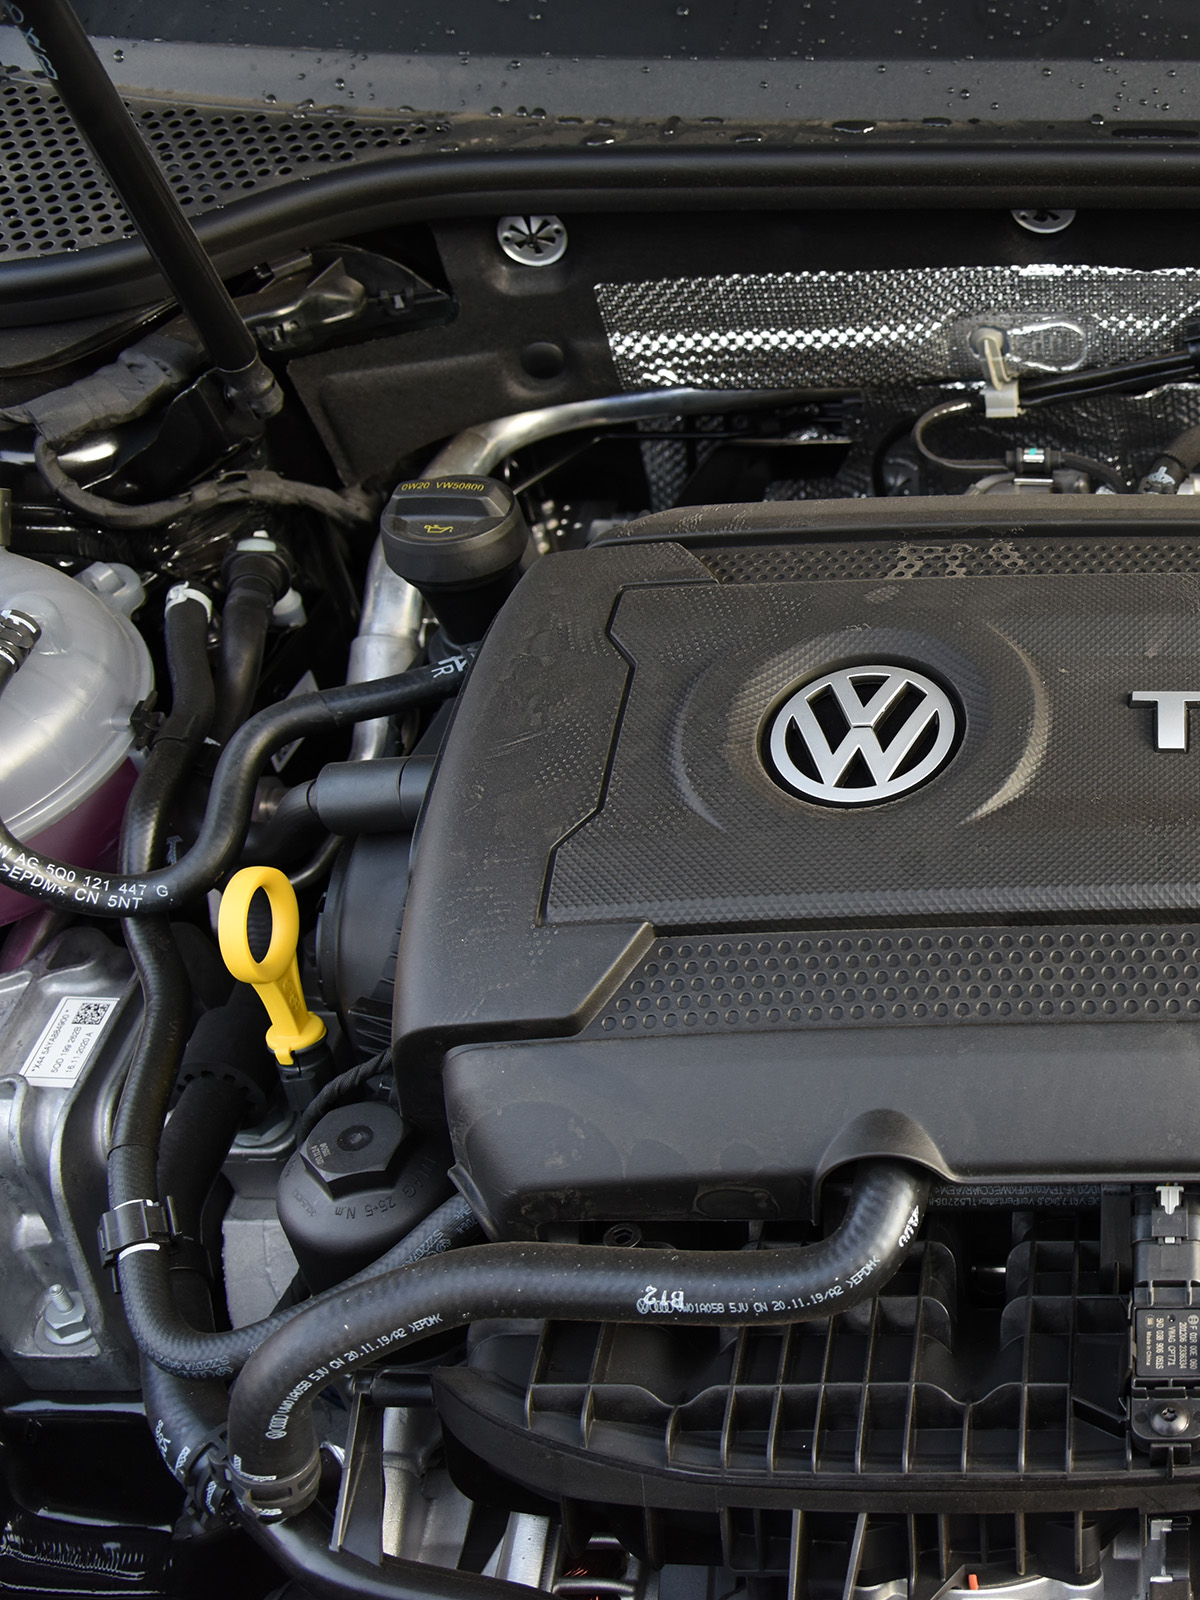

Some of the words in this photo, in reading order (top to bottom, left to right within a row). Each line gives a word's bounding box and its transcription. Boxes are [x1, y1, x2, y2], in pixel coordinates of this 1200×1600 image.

[401, 482, 430, 491] 0W20
[436, 482, 485, 492] VW50800
[14, 852, 40, 870] AG
[46, 863, 76, 883] 5Q0
[83, 876, 110, 892] 121
[119, 883, 147, 896] 447
[156, 885, 169, 897] G
[74, 888, 100, 904] CN
[108, 895, 143, 910] 5NT
[753, 1302, 768, 1312] CN
[771, 1285, 844, 1312] 20.11.19/A2
[329, 1358, 346, 1370] CN
[344, 1327, 408, 1362] 20.11.19/A2
